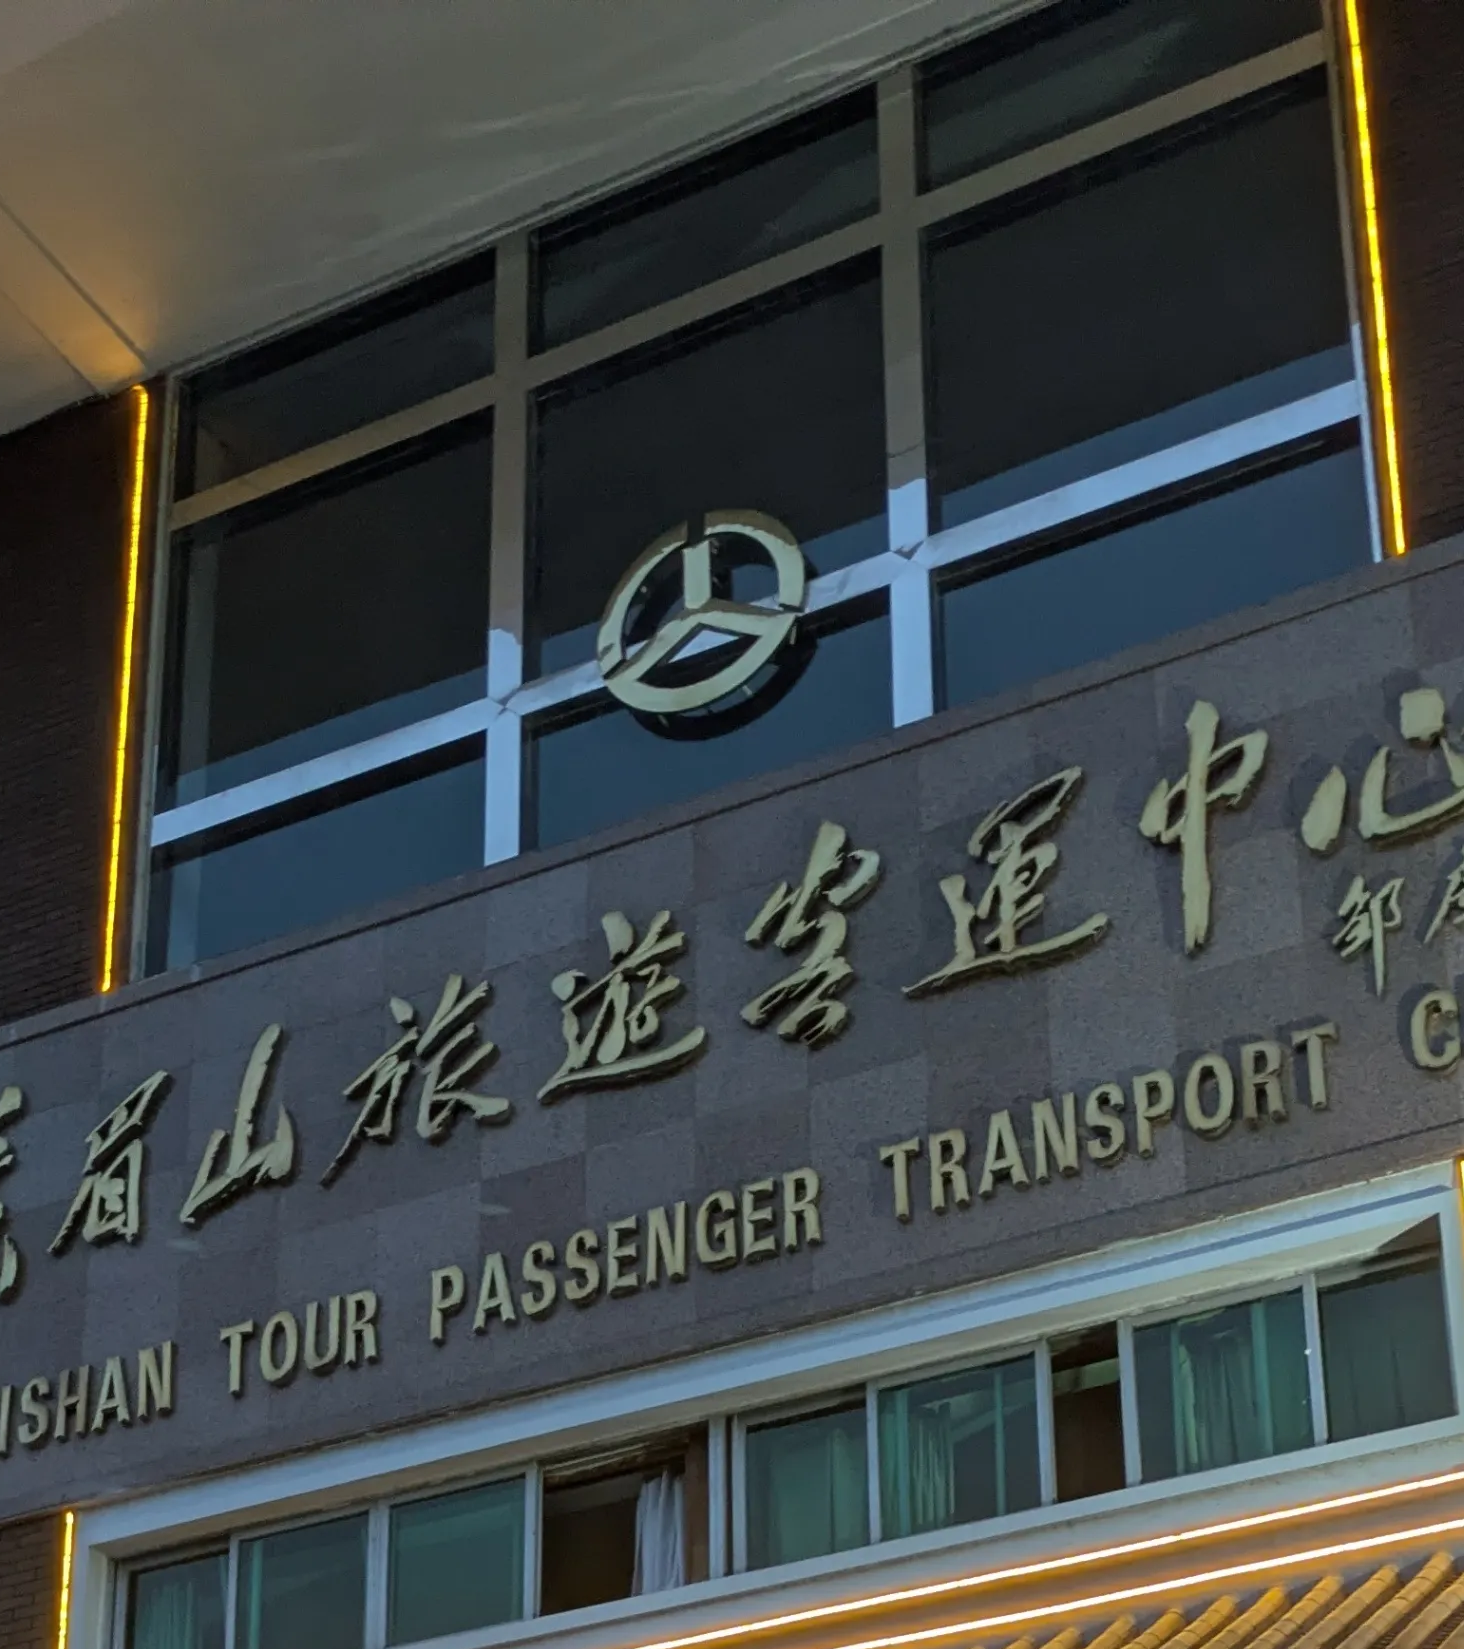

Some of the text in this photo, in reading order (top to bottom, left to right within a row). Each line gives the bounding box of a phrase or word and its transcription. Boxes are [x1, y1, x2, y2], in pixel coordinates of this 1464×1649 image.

[220, 1288, 379, 1397] TOUR
[430, 1167, 824, 1344] PASSENGER
[880, 1022, 1338, 1223] TRANSPORT
